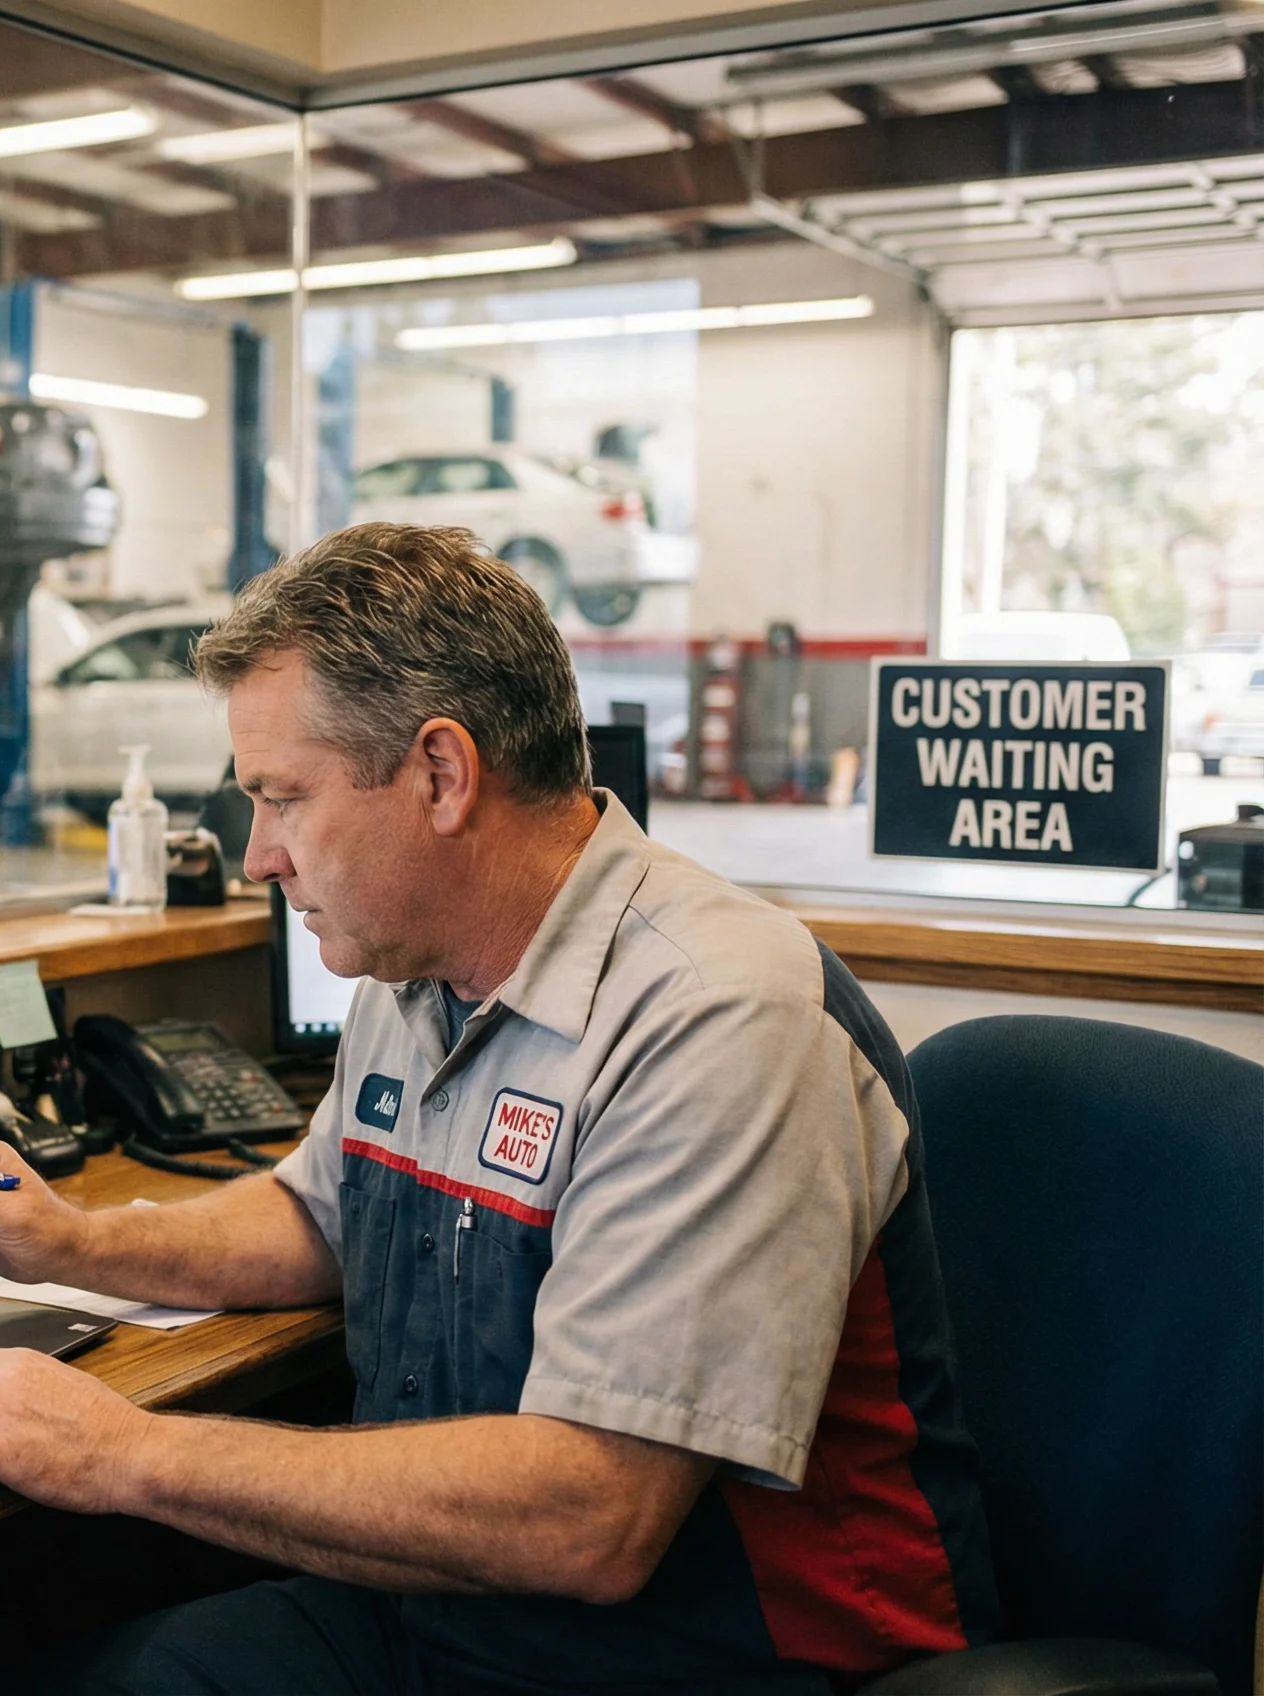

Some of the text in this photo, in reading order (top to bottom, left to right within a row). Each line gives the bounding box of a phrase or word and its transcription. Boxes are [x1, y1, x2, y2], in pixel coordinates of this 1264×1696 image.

[891, 676, 1147, 732] CUSTOMER
[916, 737, 1115, 793] WAITING
[948, 798, 1074, 852] AREA
[497, 1102, 555, 1142] MIKE'S
[494, 1134, 538, 1169] AUTO
